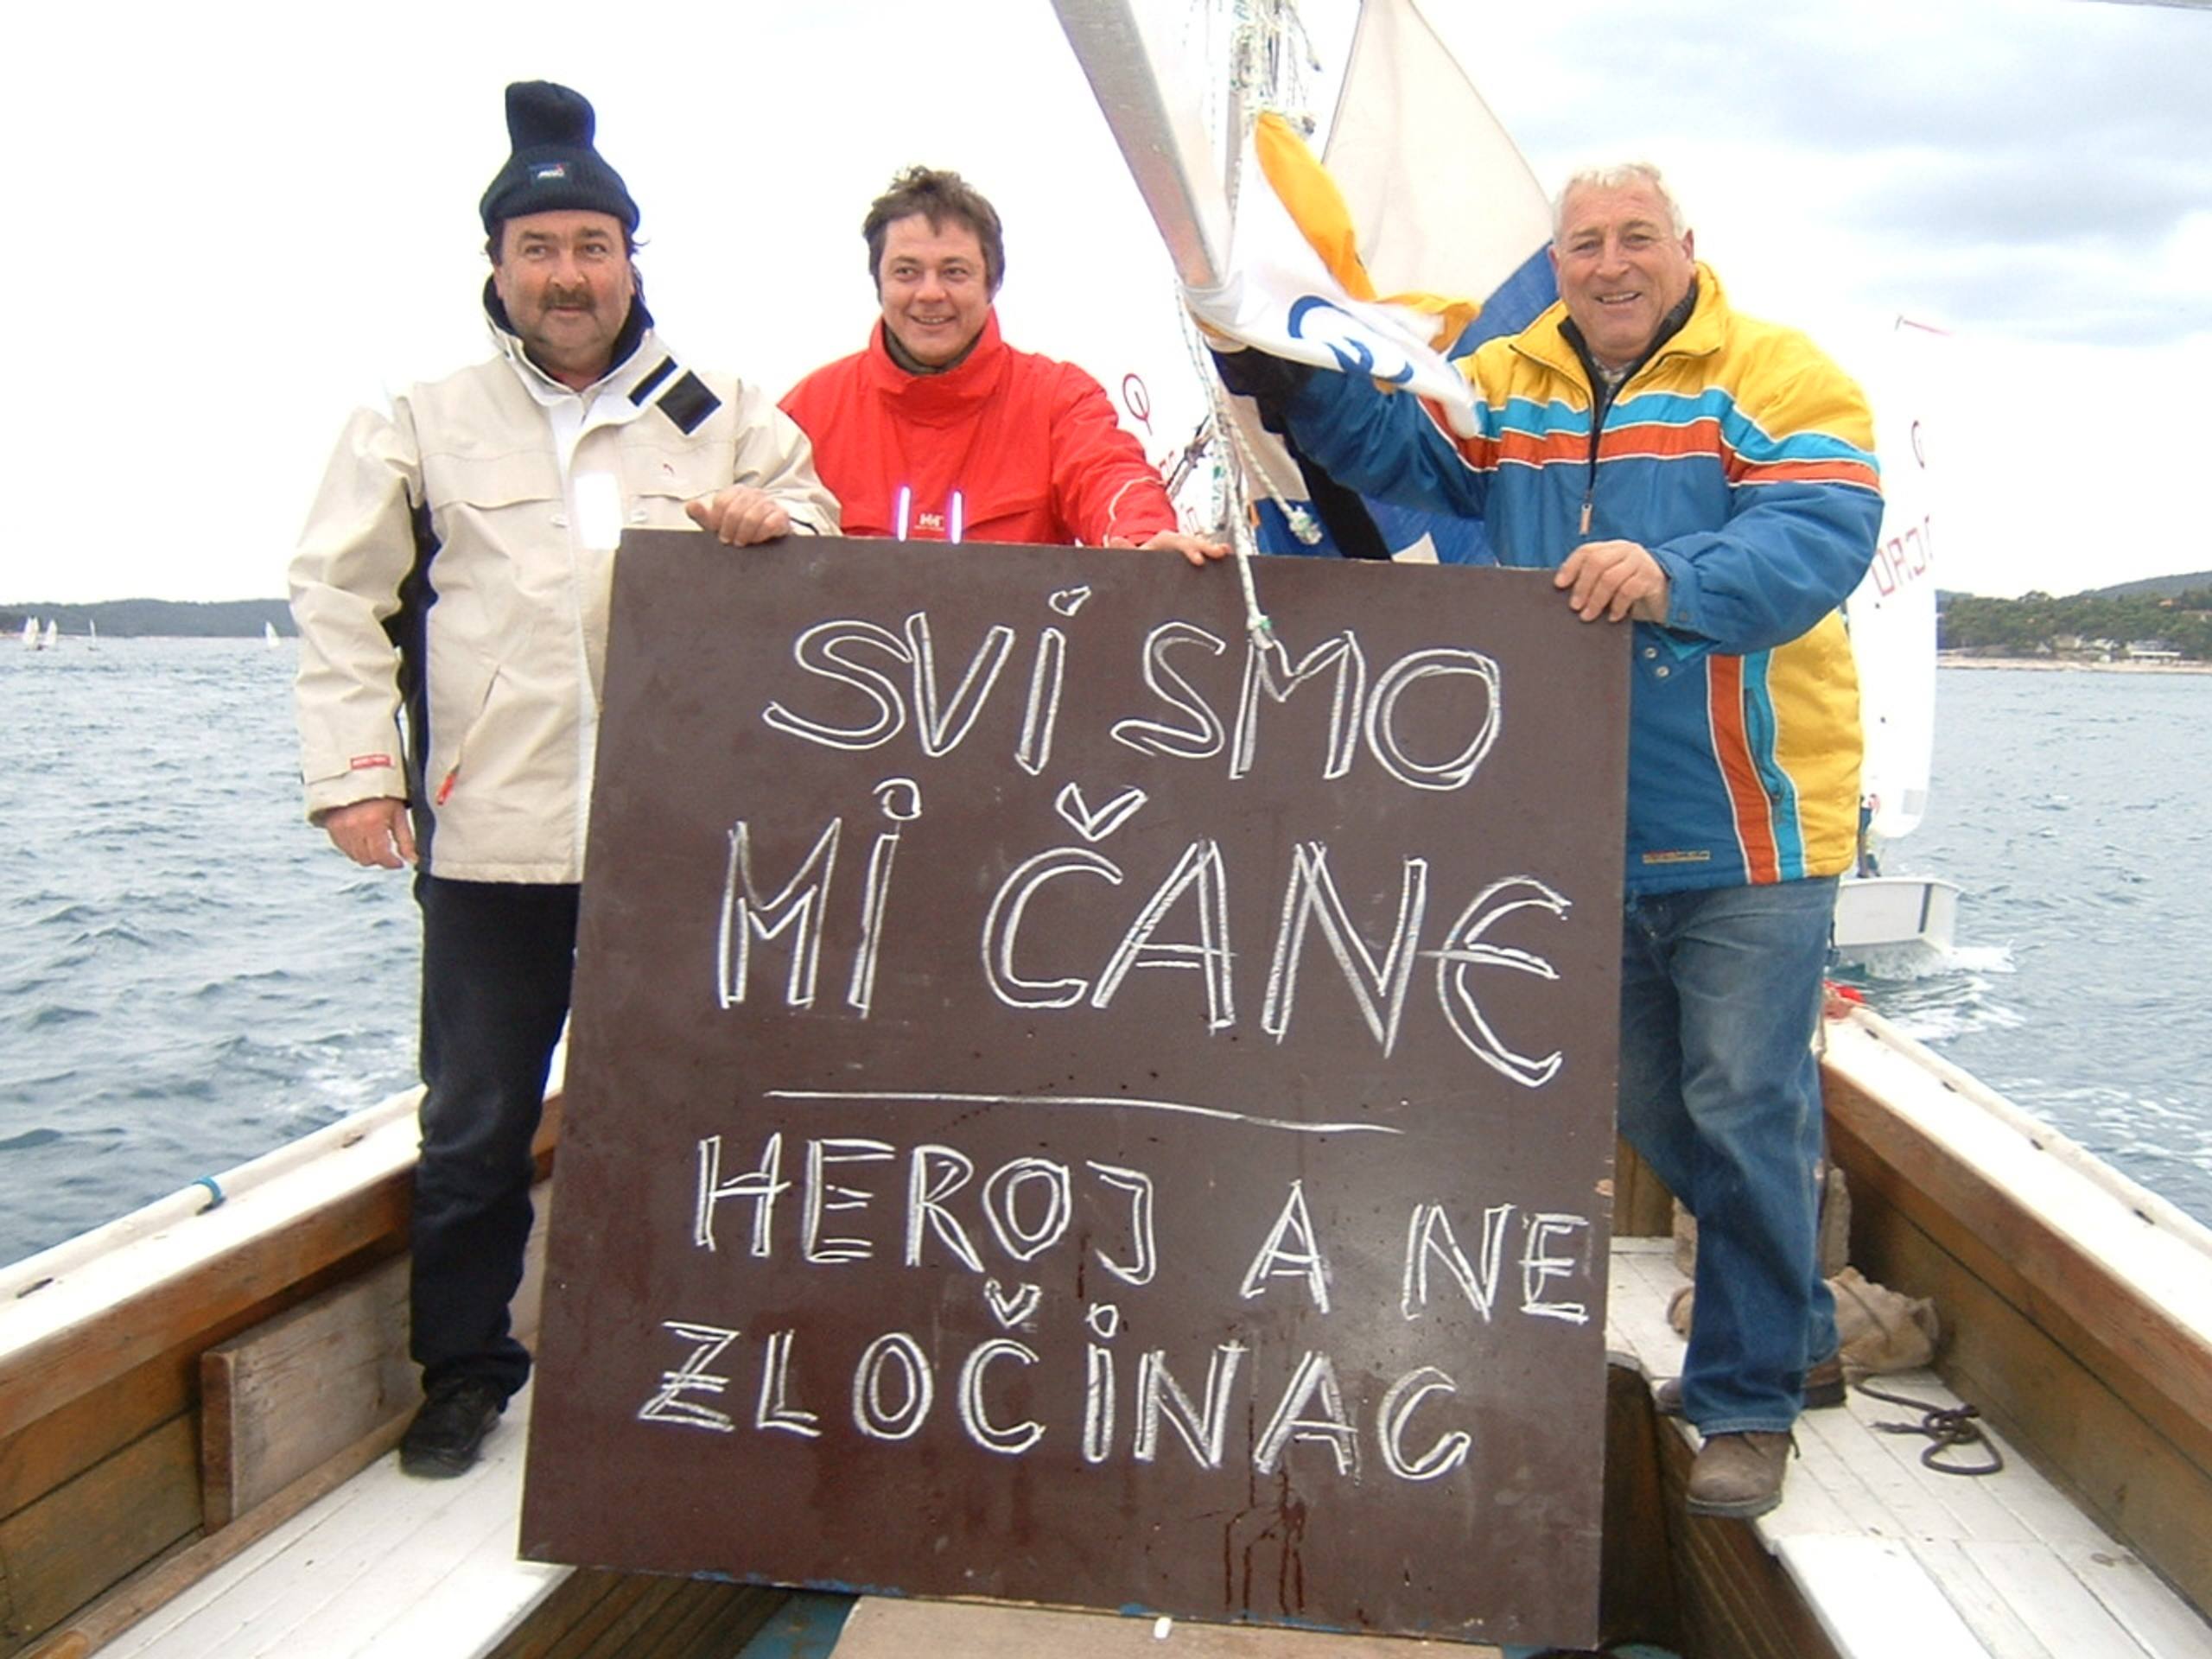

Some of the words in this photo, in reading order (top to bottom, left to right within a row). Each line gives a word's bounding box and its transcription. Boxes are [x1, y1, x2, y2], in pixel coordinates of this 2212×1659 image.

[1110, 620, 1502, 791] SMO
[696, 1132, 1156, 1285] HEROJ
[1241, 1179, 1330, 1313] A
[1401, 1203, 1591, 1323] NE
[637, 1280, 1472, 1484] ZLOČINAC
